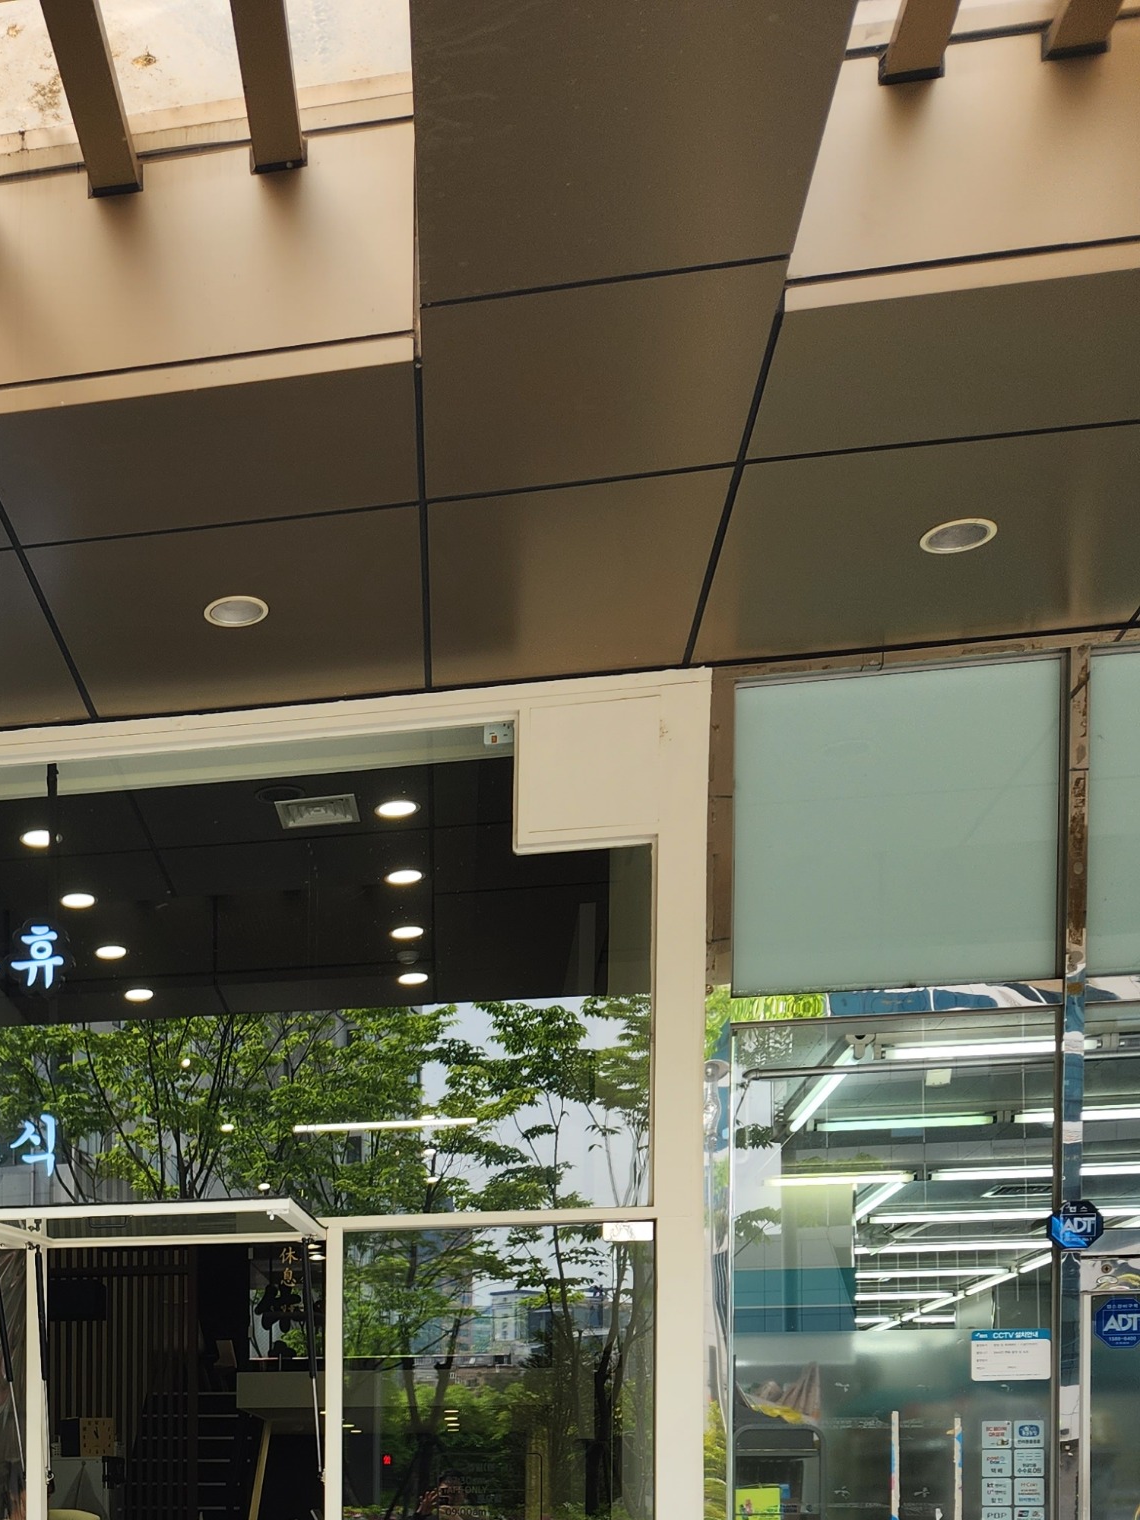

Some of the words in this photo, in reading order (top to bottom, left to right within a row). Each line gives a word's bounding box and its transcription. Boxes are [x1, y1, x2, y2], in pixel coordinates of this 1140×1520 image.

[11, 926, 64, 989] 휴
[10, 1115, 59, 1177] 식
[1062, 1217, 1096, 1233] ADT
[1103, 1314, 1140, 1331] ADT
